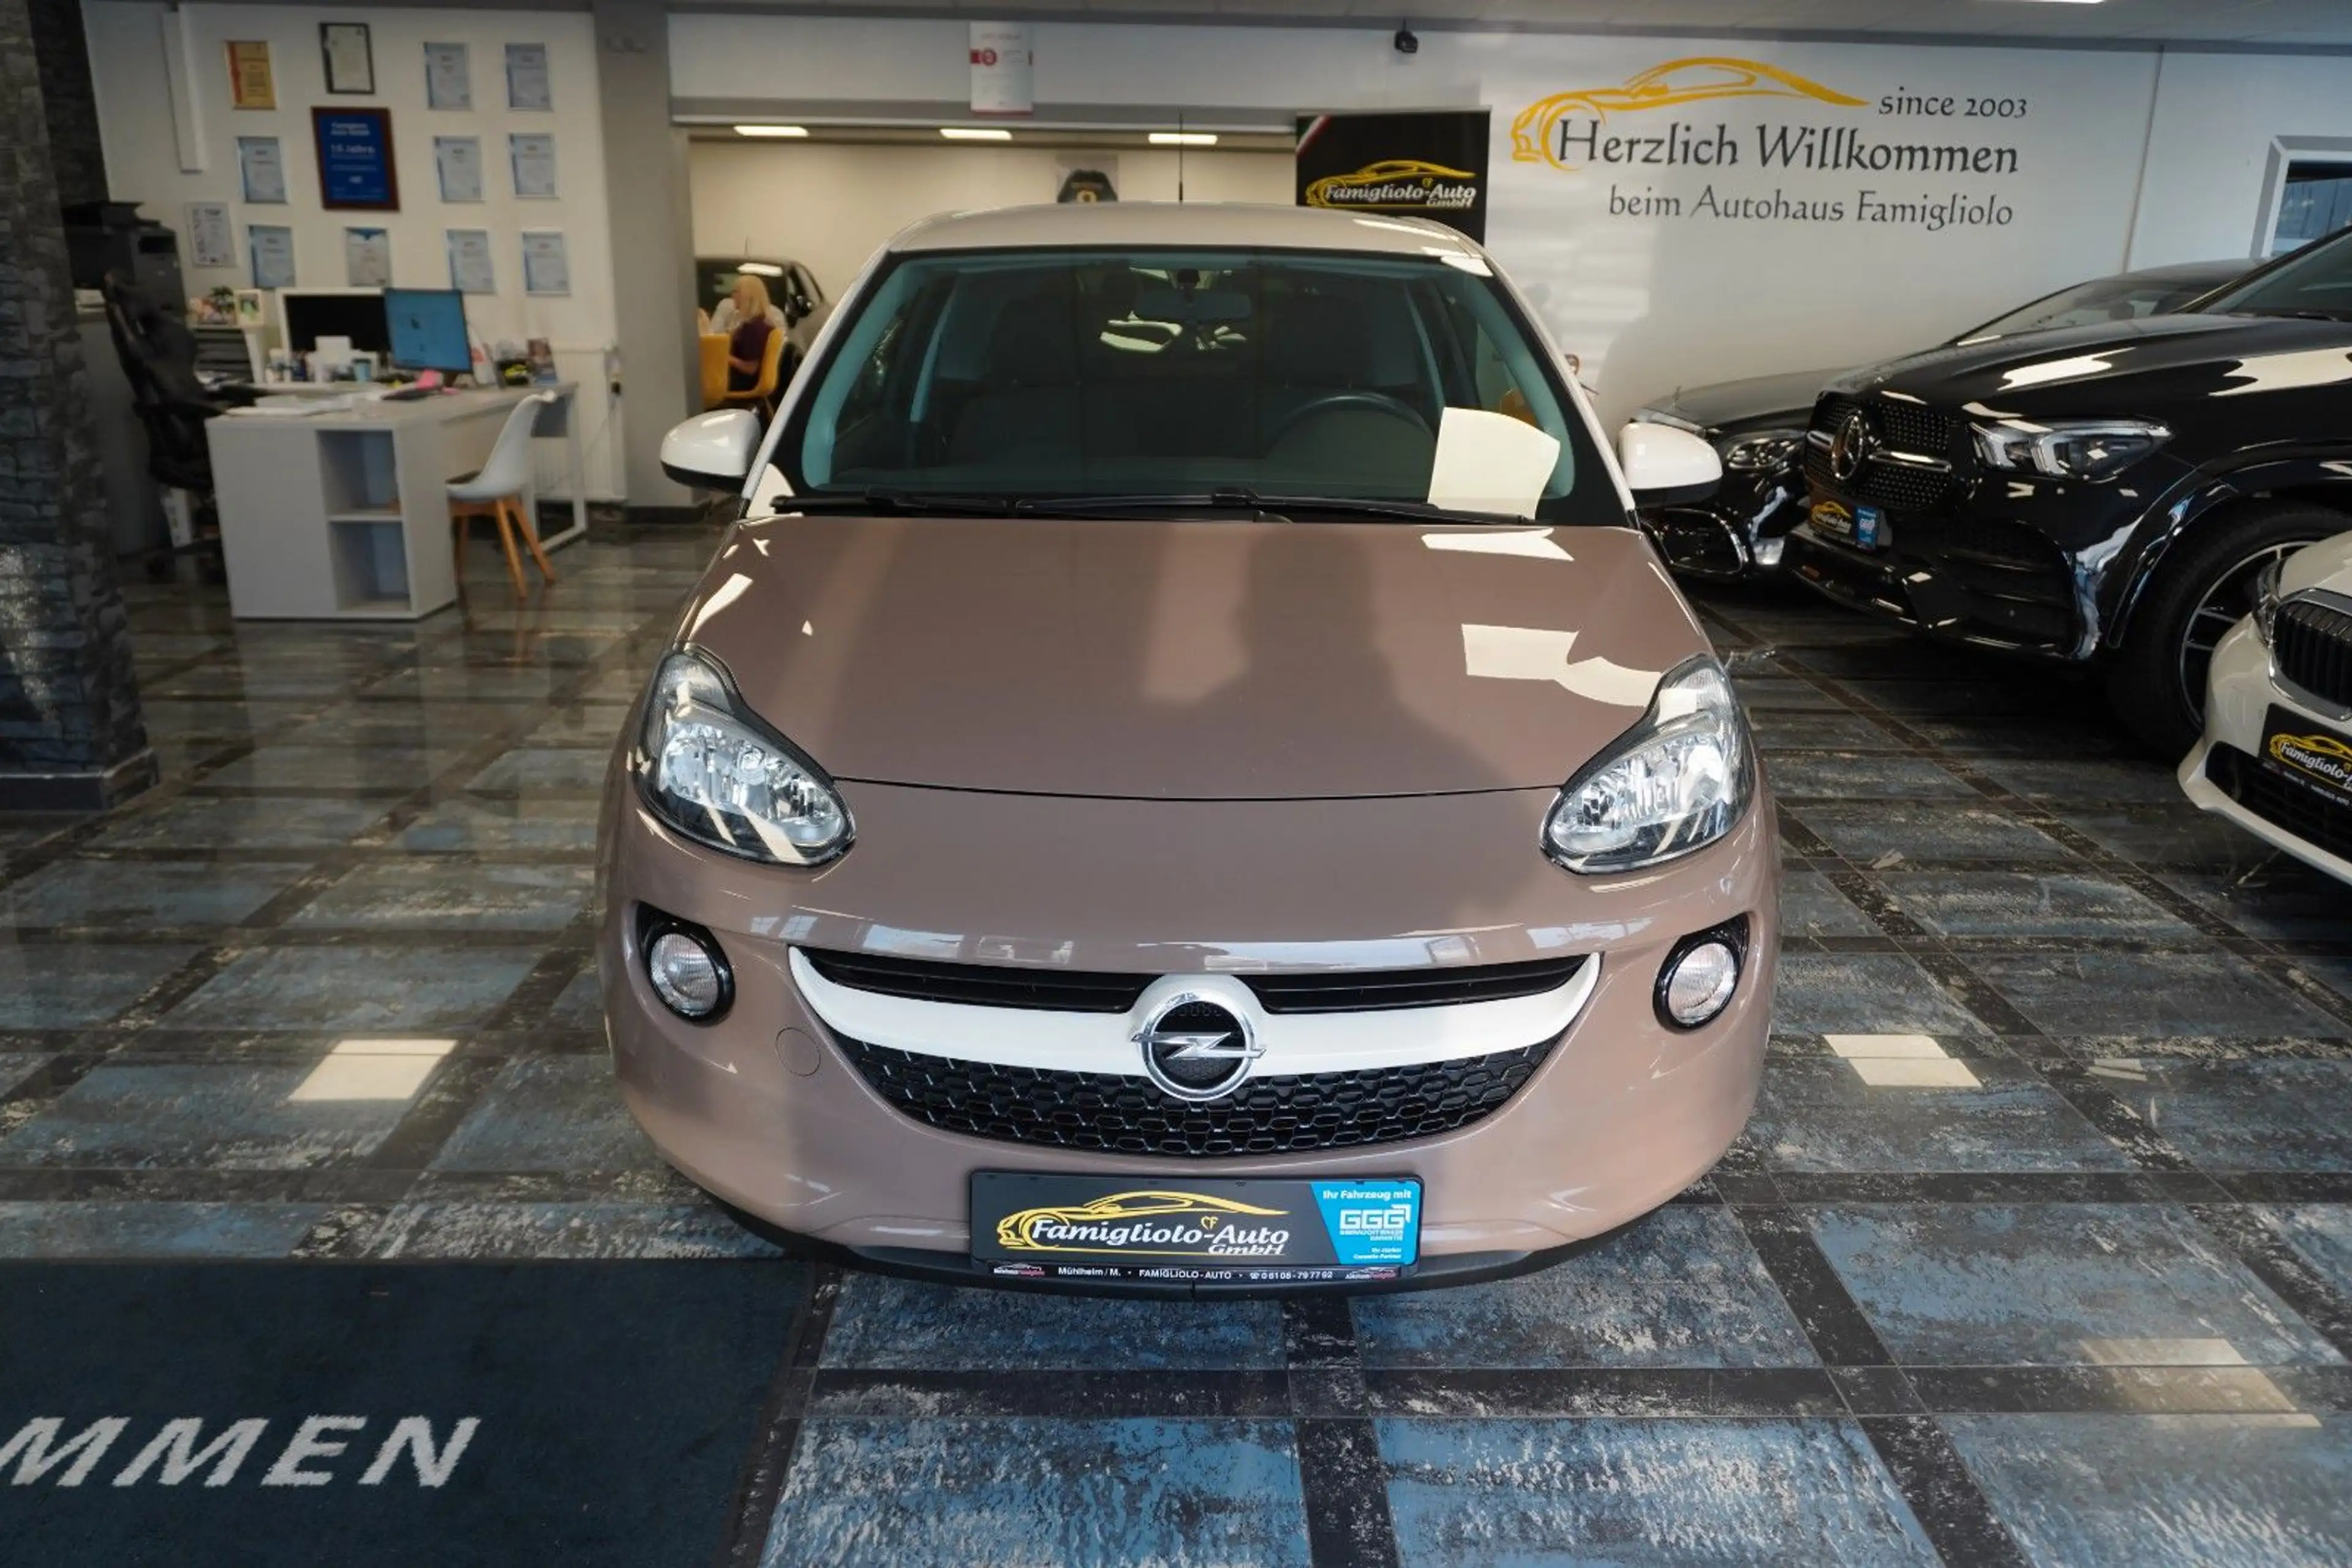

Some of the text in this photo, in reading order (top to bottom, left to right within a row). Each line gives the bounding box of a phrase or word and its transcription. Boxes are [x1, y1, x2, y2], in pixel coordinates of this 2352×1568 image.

[1879, 86, 2027, 119] since 2003
[1558, 119, 2019, 173] Herzlich Willkommen
[1609, 184, 2013, 231] beim Autohaus Famigliolo
[1323, 1189, 1412, 1201] Ihr Fahrzeug mit
[1207, 1244, 1285, 1255] GmbH
[0, 1415, 481, 1488] MMEN
